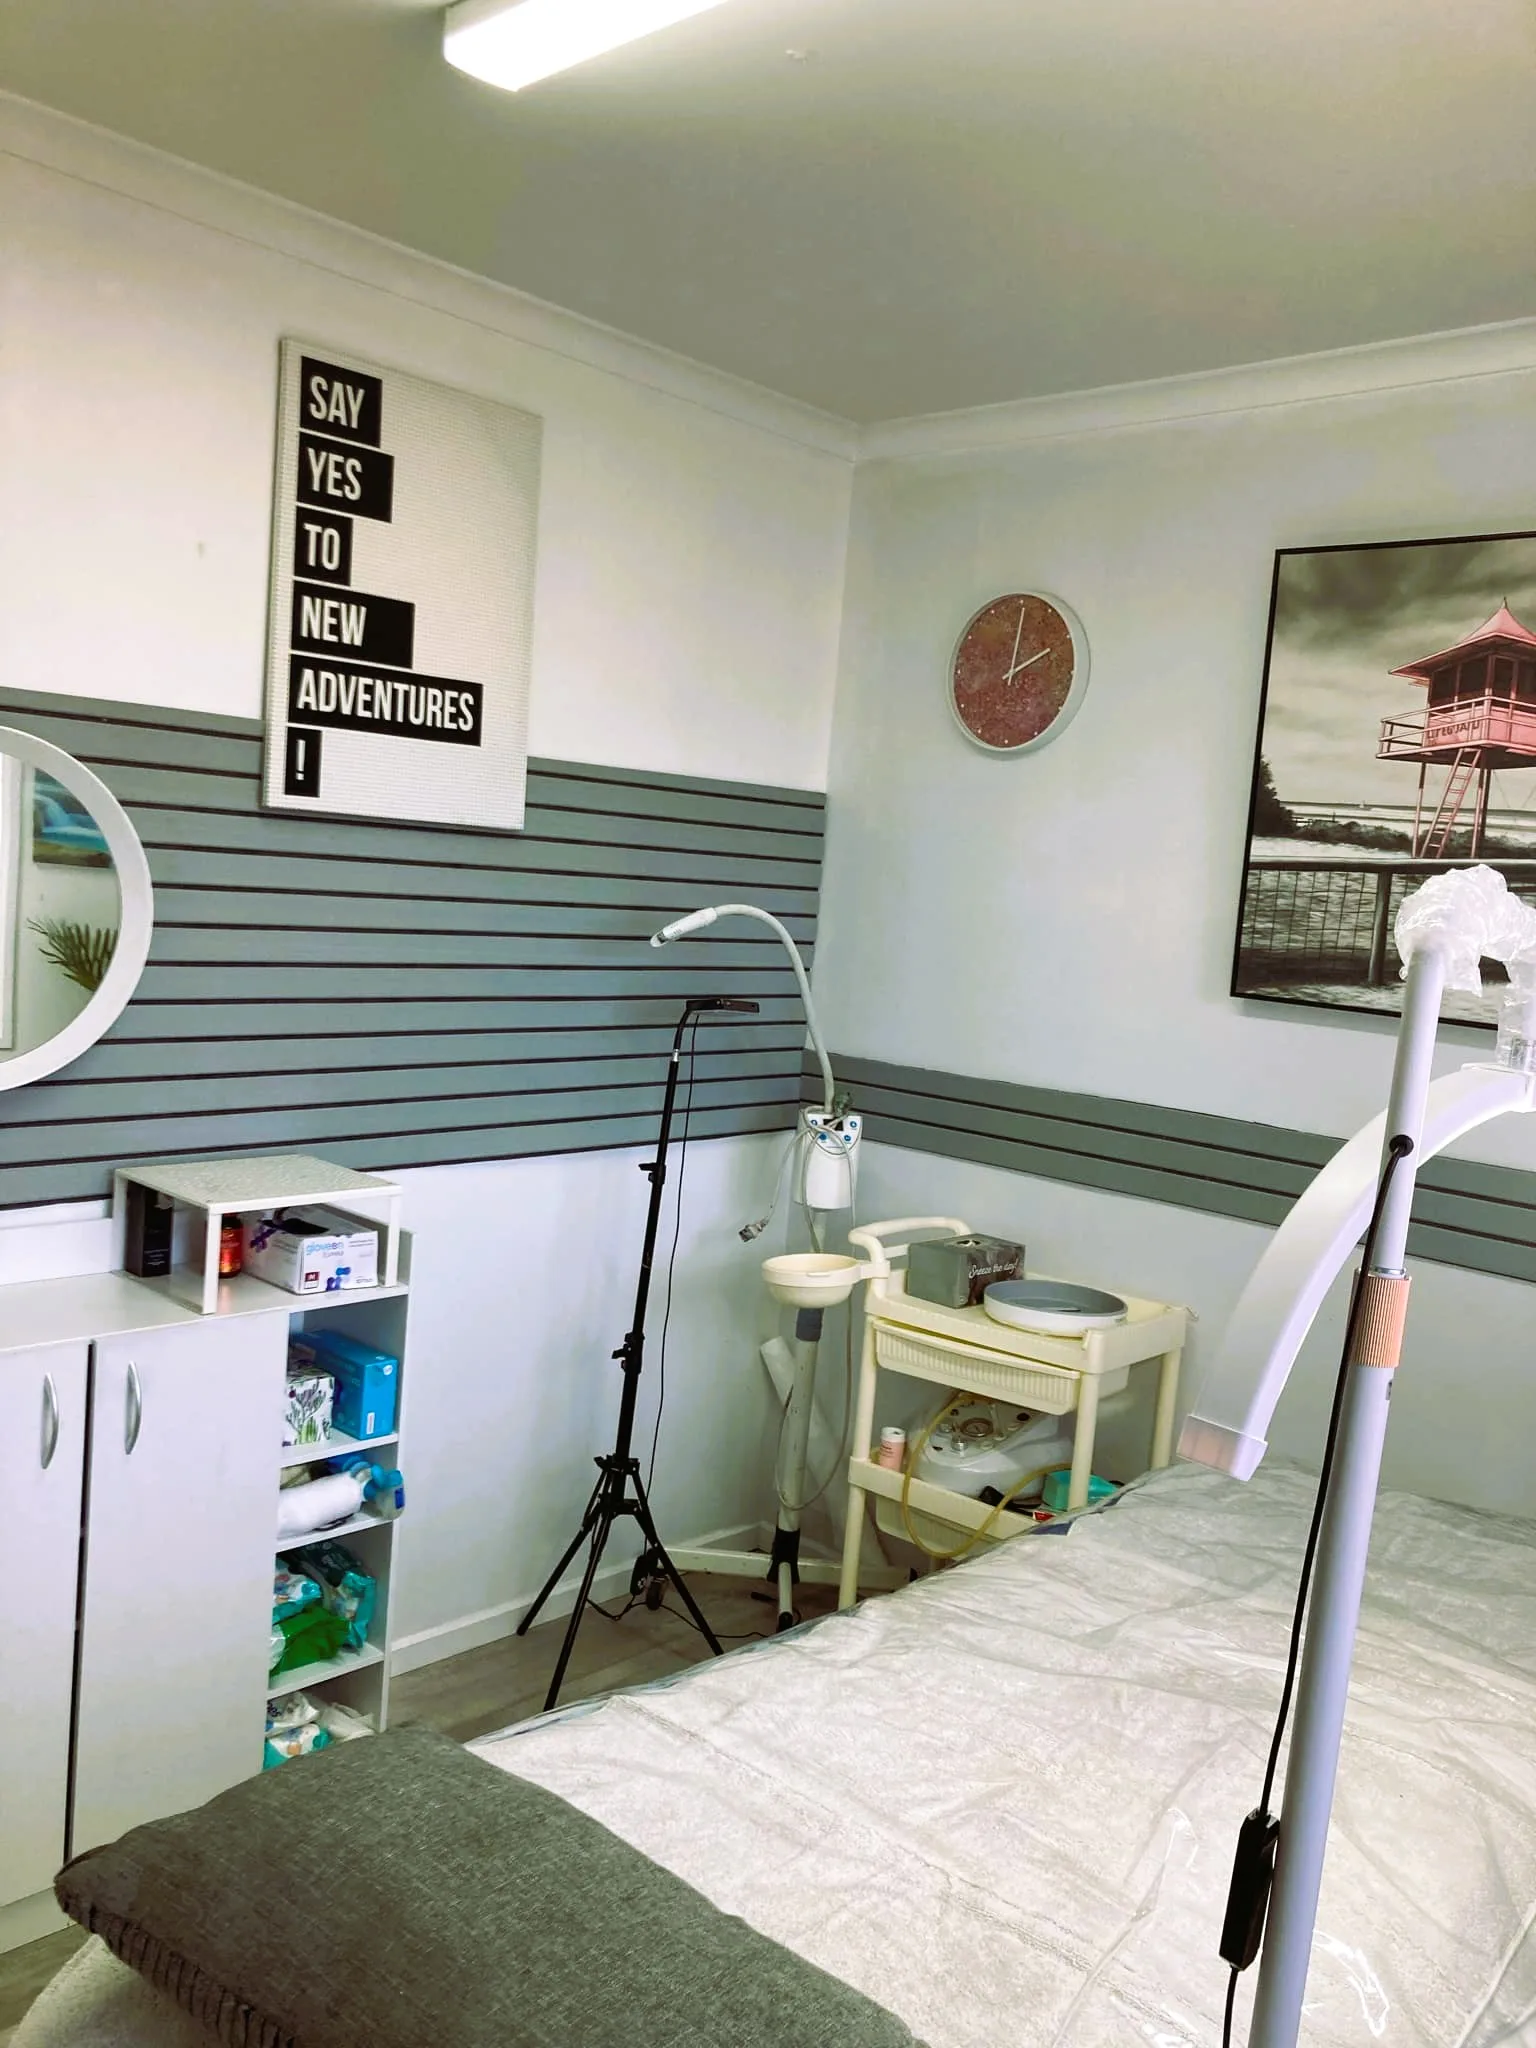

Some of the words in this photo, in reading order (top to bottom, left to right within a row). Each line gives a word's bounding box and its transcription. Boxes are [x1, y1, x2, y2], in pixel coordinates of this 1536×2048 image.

[309, 375, 366, 430] SAY
[306, 447, 363, 501] YES
[304, 522, 341, 571] TO
[300, 595, 367, 648] NEW
[297, 668, 475, 732] ADVENTURES
[296, 739, 306, 781] !
